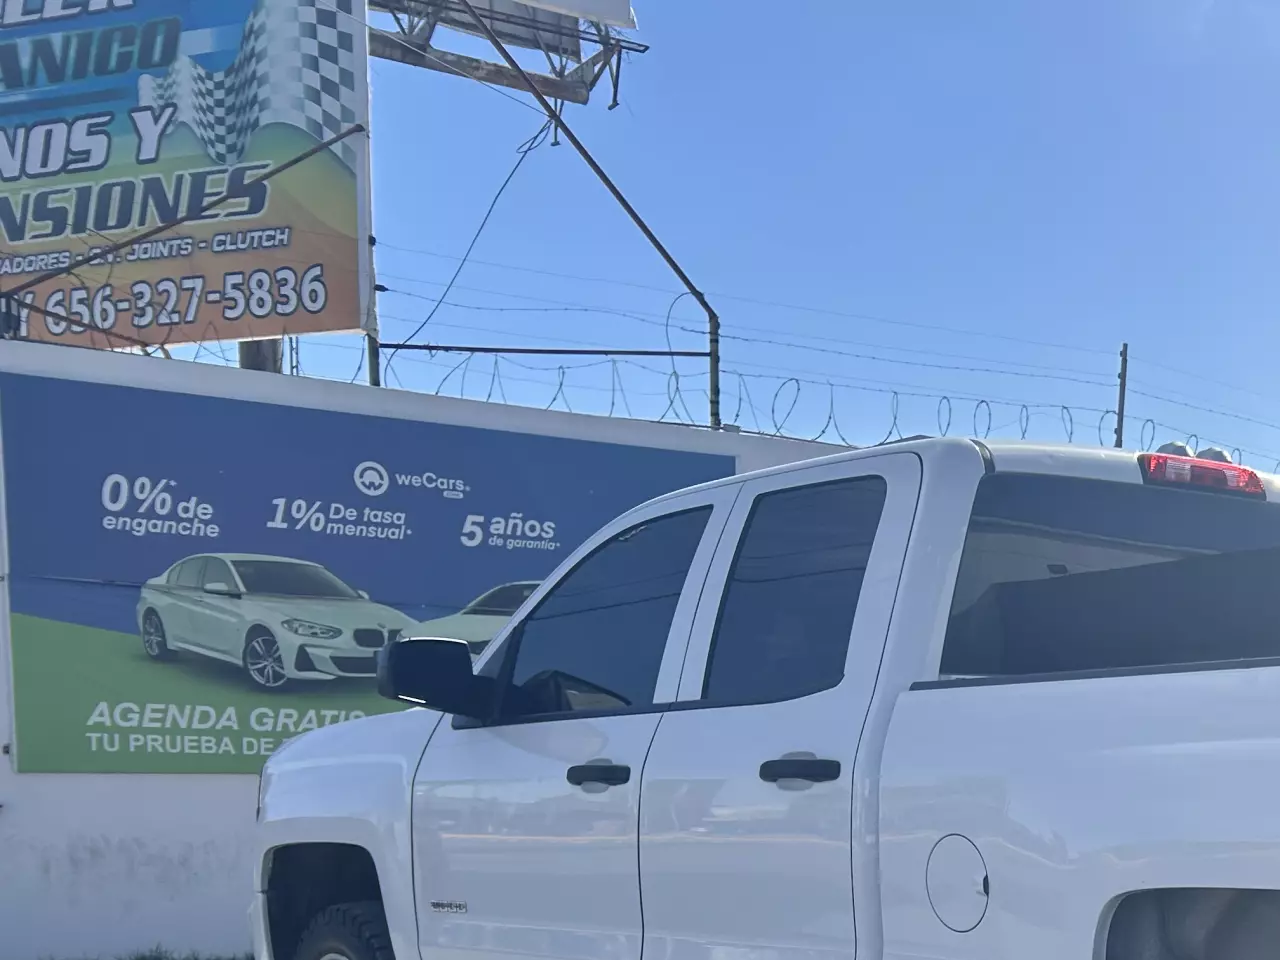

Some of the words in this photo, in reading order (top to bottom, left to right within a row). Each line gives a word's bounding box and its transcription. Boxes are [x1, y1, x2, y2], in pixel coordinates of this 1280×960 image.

[128, 102, 178, 165] Y
[125, 239, 193, 263] JOINTS
[211, 227, 290, 254] CLUTCH
[43, 263, 328, 337] 656-327-5836
[395, 472, 465, 492] weCars
[176, 496, 214, 520] de
[266, 497, 326, 532] 1%
[329, 502, 358, 521] De
[363, 506, 406, 525] tasa
[102, 515, 221, 538] enganche
[460, 514, 486, 548] 5
[489, 512, 557, 539] años
[488, 535, 504, 547] de
[86, 701, 240, 732] AGENDA
[85, 732, 121, 752] TU
[128, 733, 236, 755] PRUEBA
[242, 736, 275, 757] DE
